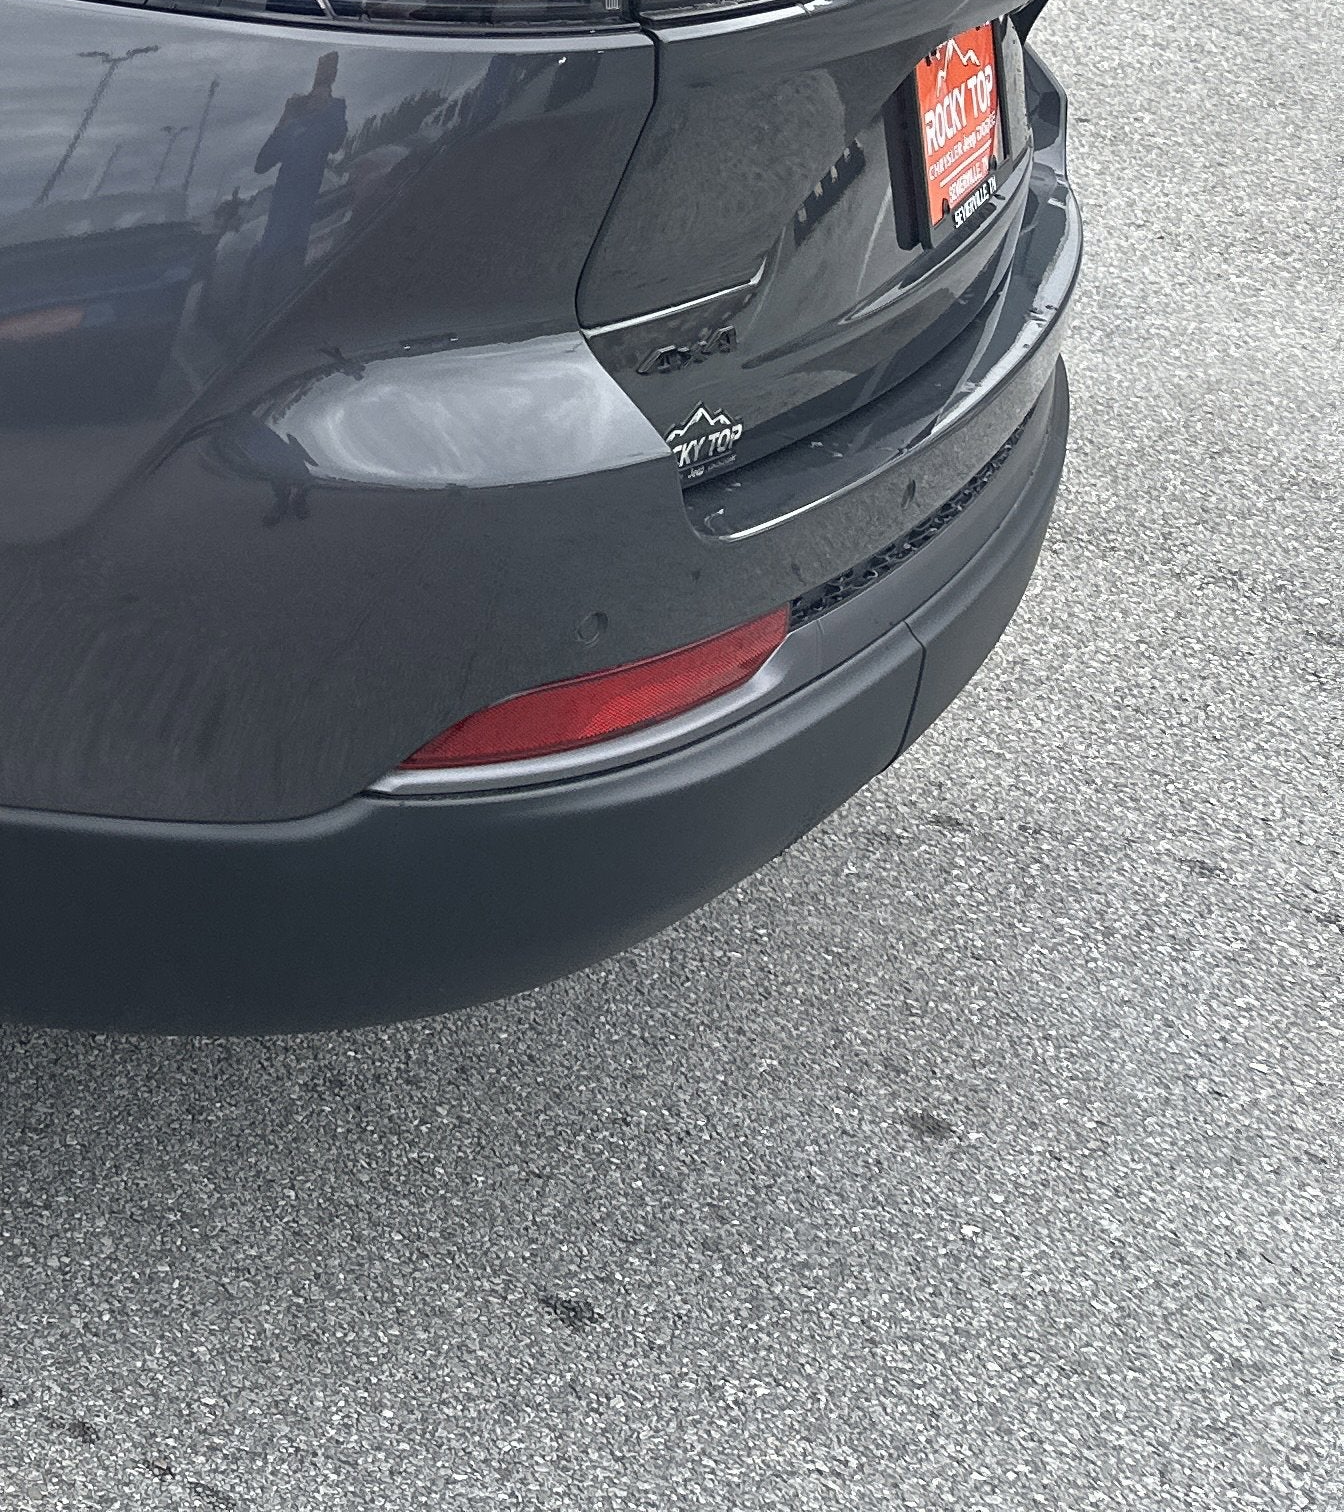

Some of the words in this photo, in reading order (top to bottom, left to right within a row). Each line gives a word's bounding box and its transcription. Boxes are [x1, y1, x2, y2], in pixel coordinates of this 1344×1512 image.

[924, 82, 967, 156] ROCKY
[966, 64, 993, 119] TOP
[929, 141, 964, 181] CHRYSLER
[954, 183, 990, 229] SEVIERVILLE
[708, 424, 743, 457] TOP
